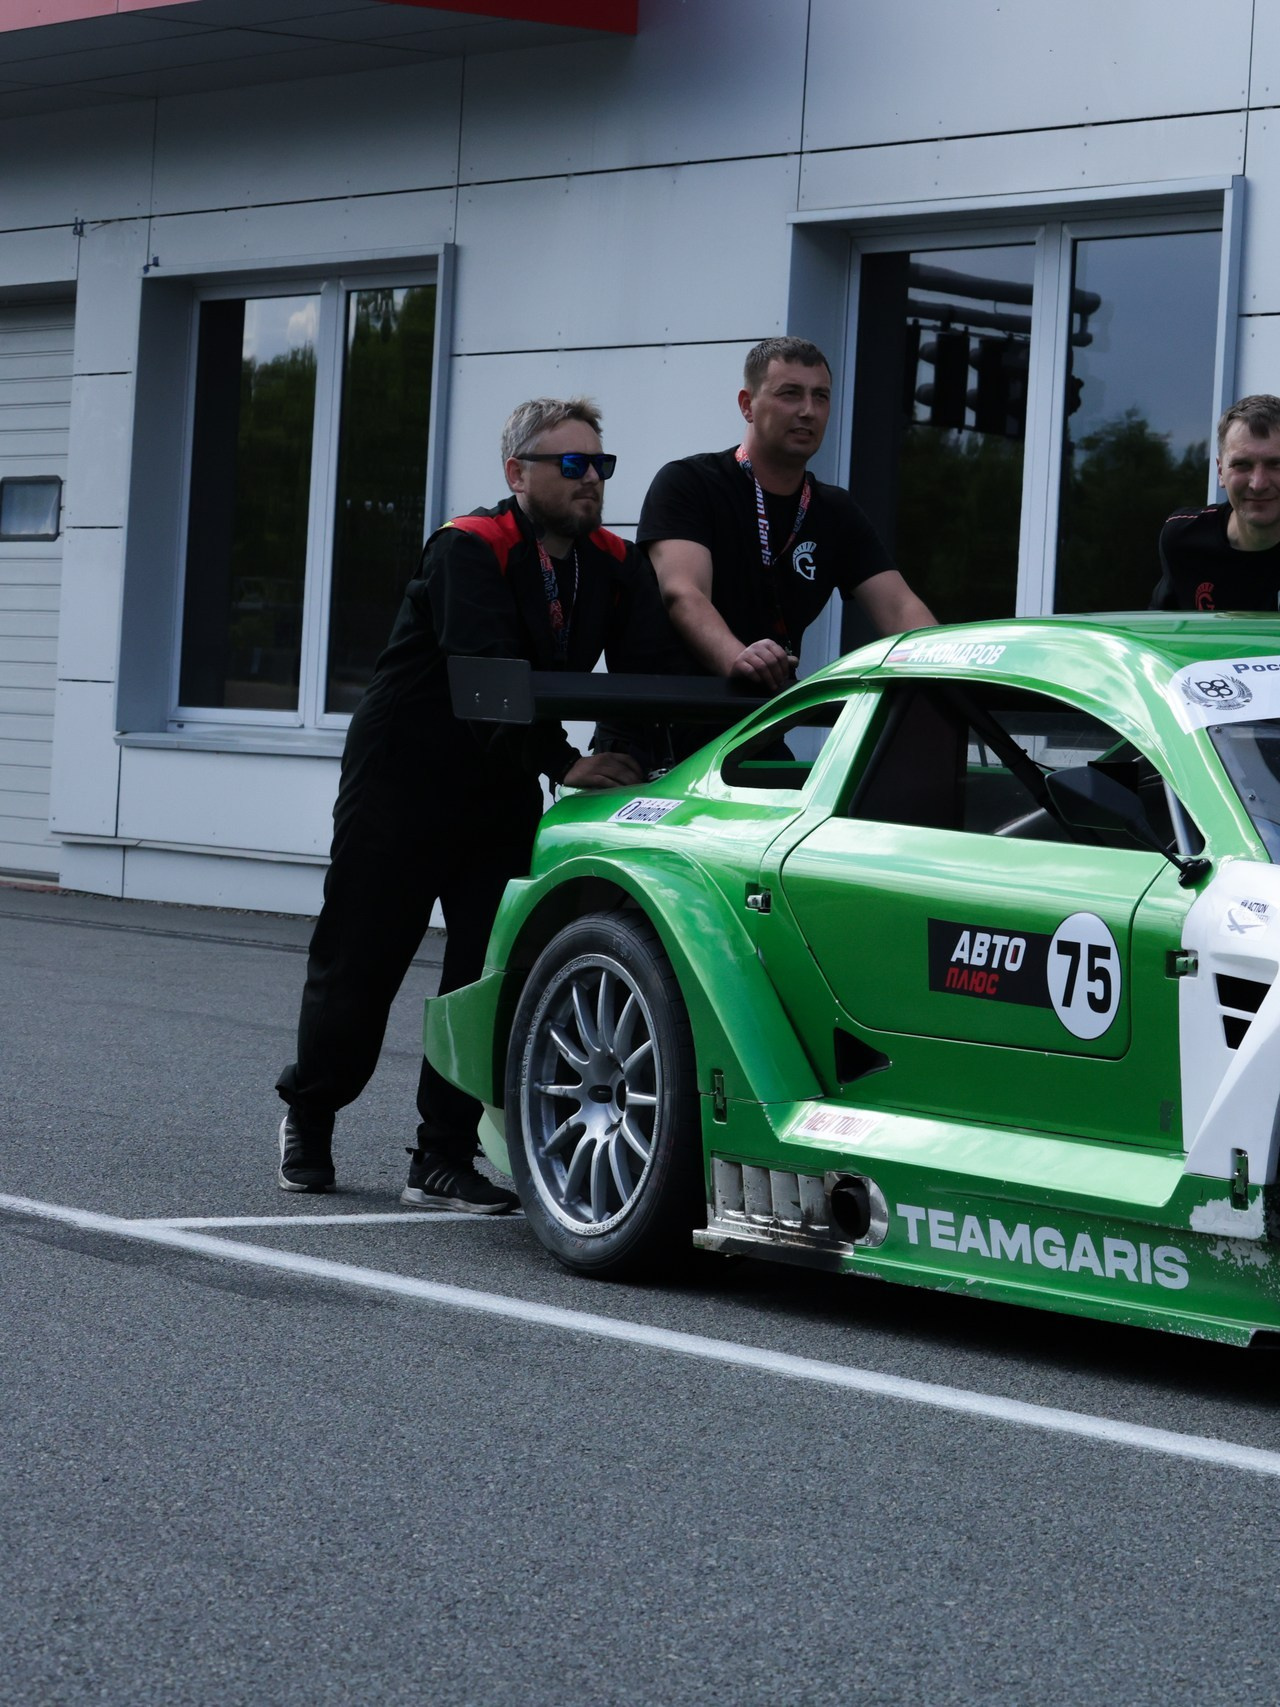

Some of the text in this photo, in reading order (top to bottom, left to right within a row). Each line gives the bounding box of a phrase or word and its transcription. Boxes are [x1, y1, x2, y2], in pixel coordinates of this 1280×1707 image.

[951, 930, 1026, 972] АВТО
[1057, 939, 1112, 1014] 75
[946, 967, 999, 996] ПЛЮС
[896, 1203, 1189, 1290] TEAMGARIS
